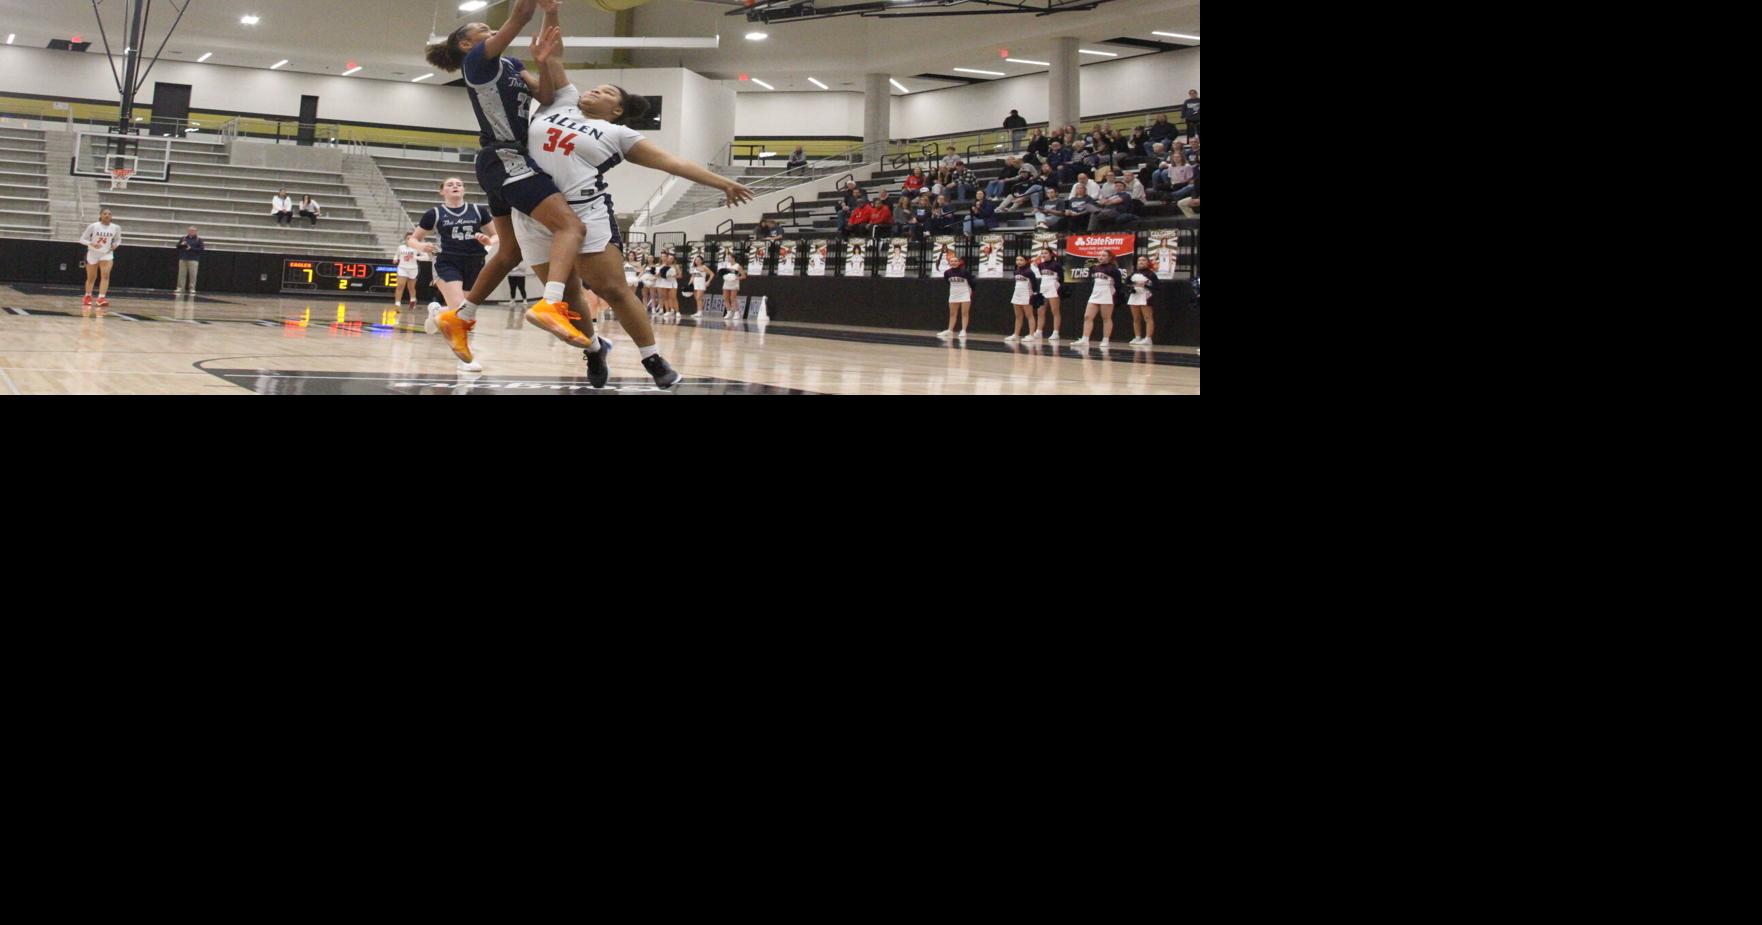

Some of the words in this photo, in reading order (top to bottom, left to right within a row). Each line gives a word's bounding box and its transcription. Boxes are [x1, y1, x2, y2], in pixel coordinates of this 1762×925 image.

[543, 113, 604, 140] ALLEN
[542, 127, 578, 156] 34
[451, 226, 475, 241] 42
[303, 269, 313, 283] 7
[334, 262, 367, 278] 7:43
[1071, 268, 1090, 278] TCHS
[338, 279, 348, 290] 2
